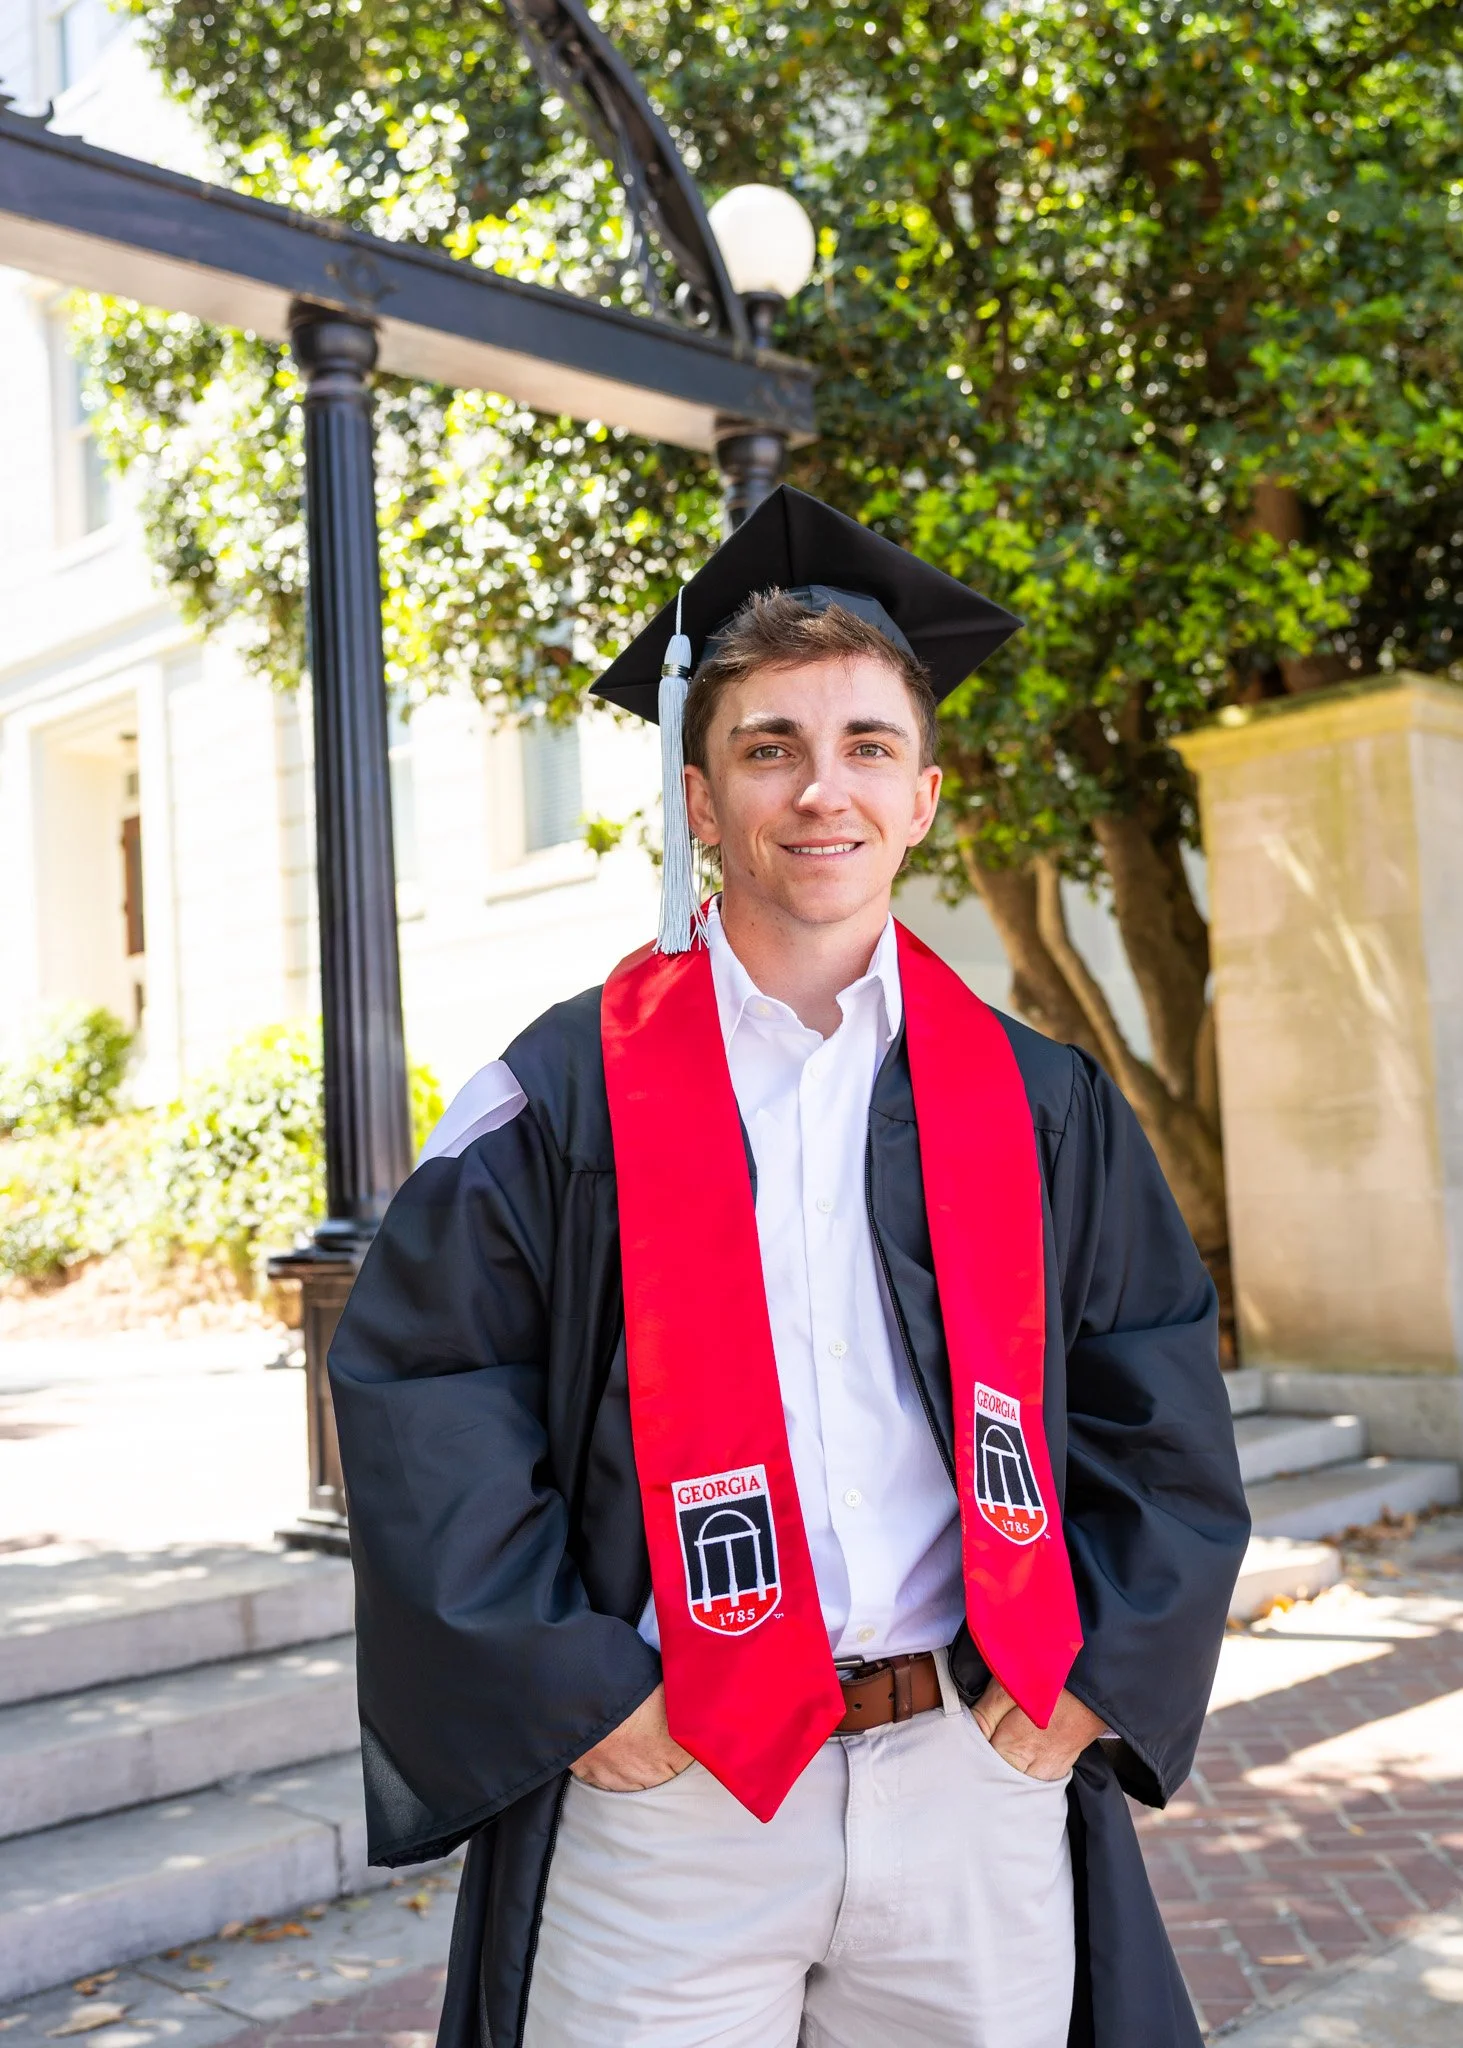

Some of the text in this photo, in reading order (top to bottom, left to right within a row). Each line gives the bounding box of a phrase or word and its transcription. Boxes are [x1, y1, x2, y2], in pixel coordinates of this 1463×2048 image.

[977, 1389, 1017, 1421] GEORGIA
[677, 1475, 761, 1505] GEORGIA
[1001, 1519, 1030, 1535] 1785
[718, 1608, 756, 1626] 1785
